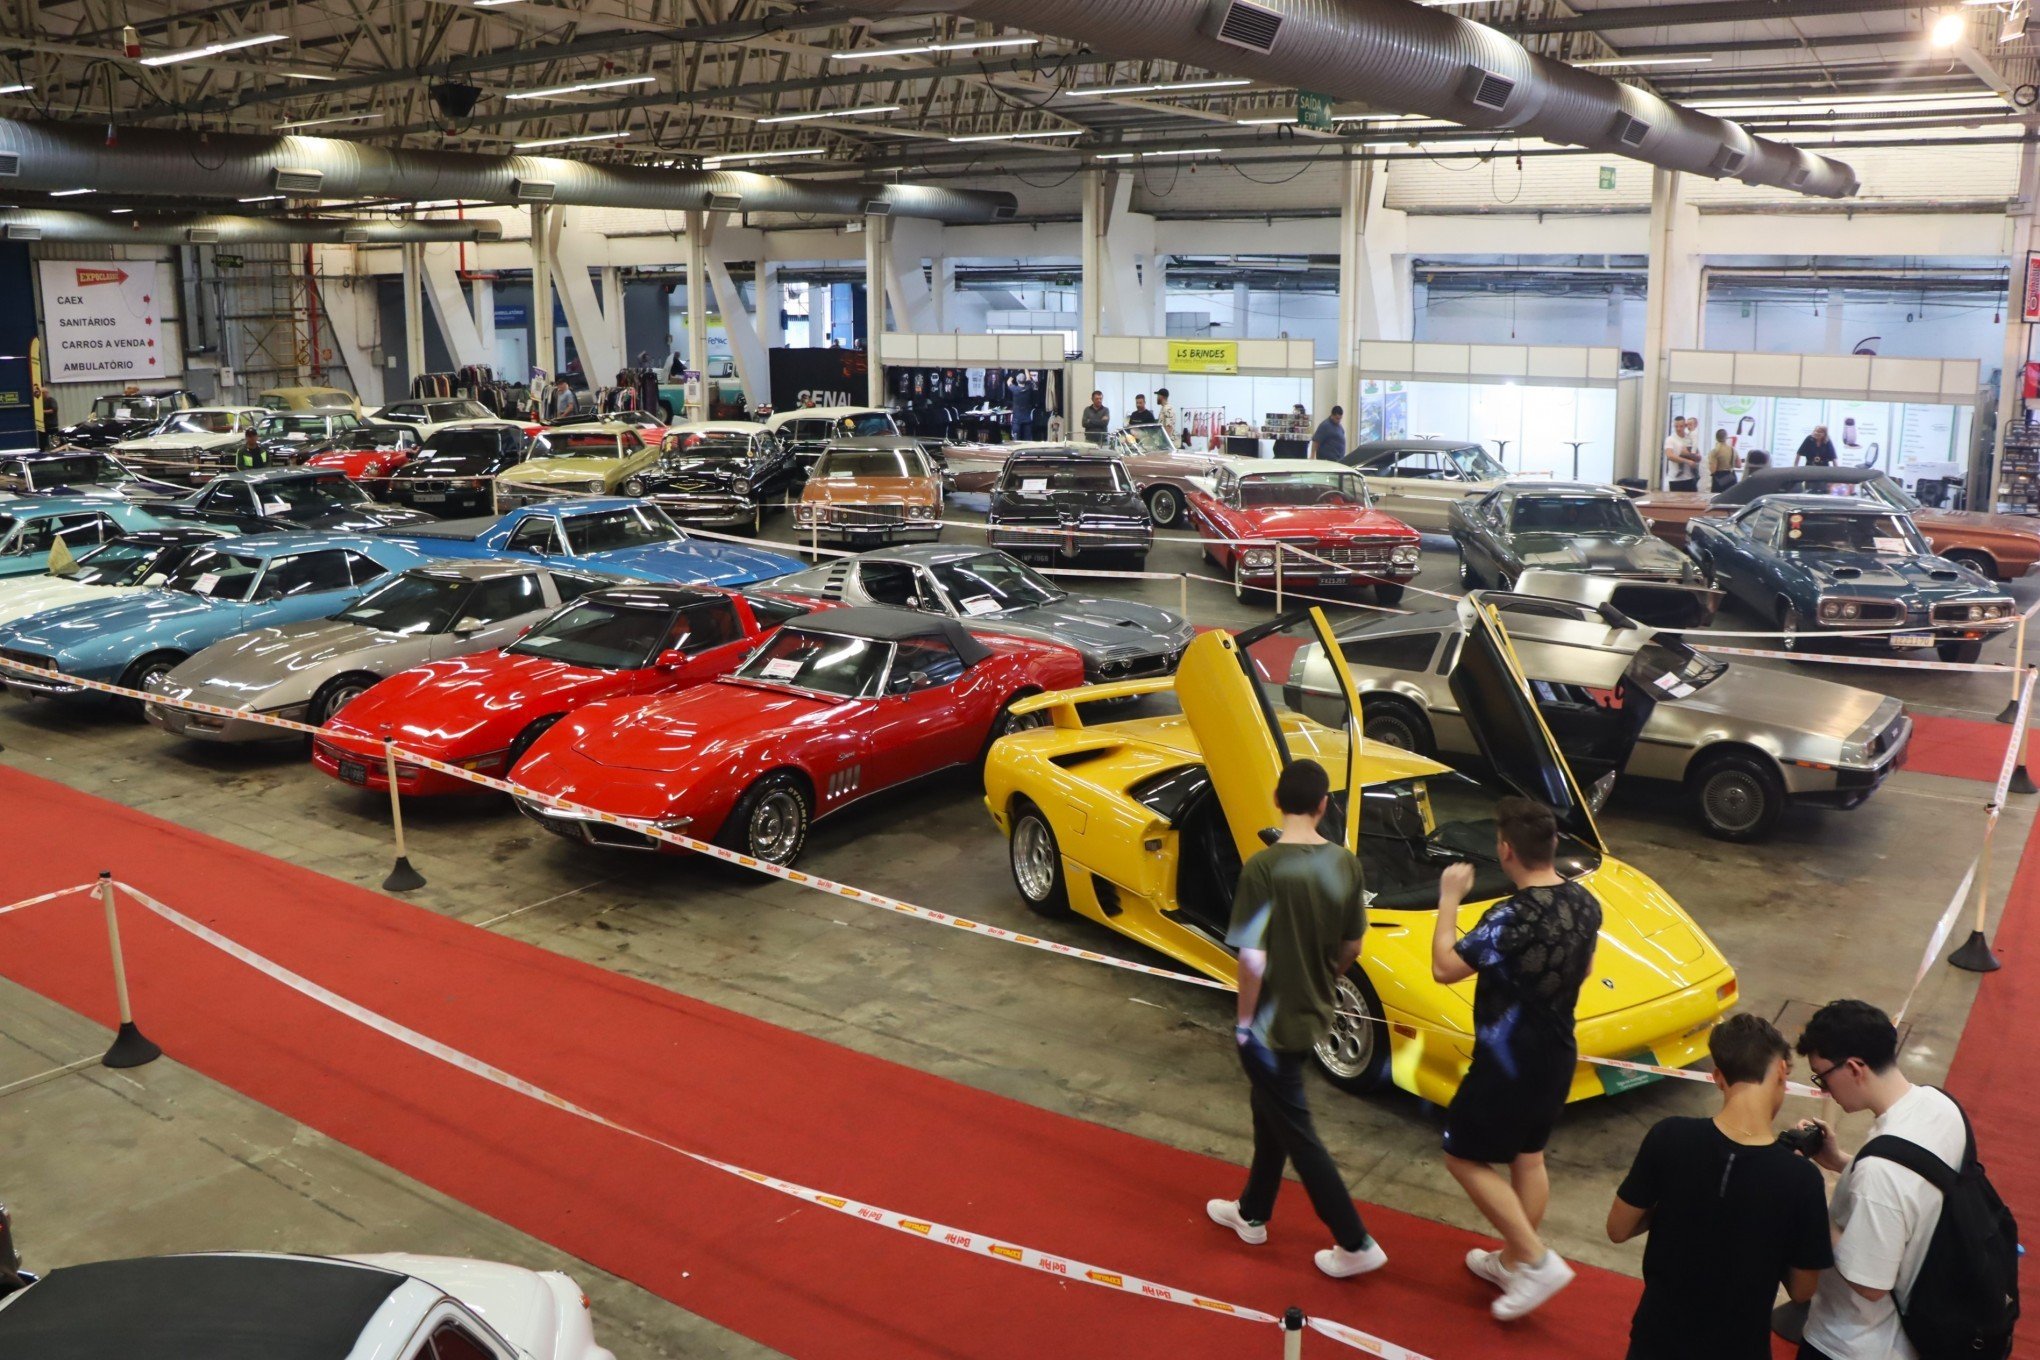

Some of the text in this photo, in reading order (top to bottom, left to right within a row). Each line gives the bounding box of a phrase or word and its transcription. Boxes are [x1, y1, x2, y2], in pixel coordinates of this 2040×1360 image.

[57, 296, 84, 305] CAEX
[60, 316, 116, 327] SANITÁRIOS
[62, 339, 146, 349] CARROS A VENDA
[1189, 349, 1225, 359] BRINDES
[64, 359, 134, 371] AMBULATÓRIO
[944, 1233, 972, 1247] Bel Air
[1039, 1258, 1052, 1270] Air
[1053, 1262, 1067, 1274] Bel
[1142, 1285, 1171, 1300] Bel Air
